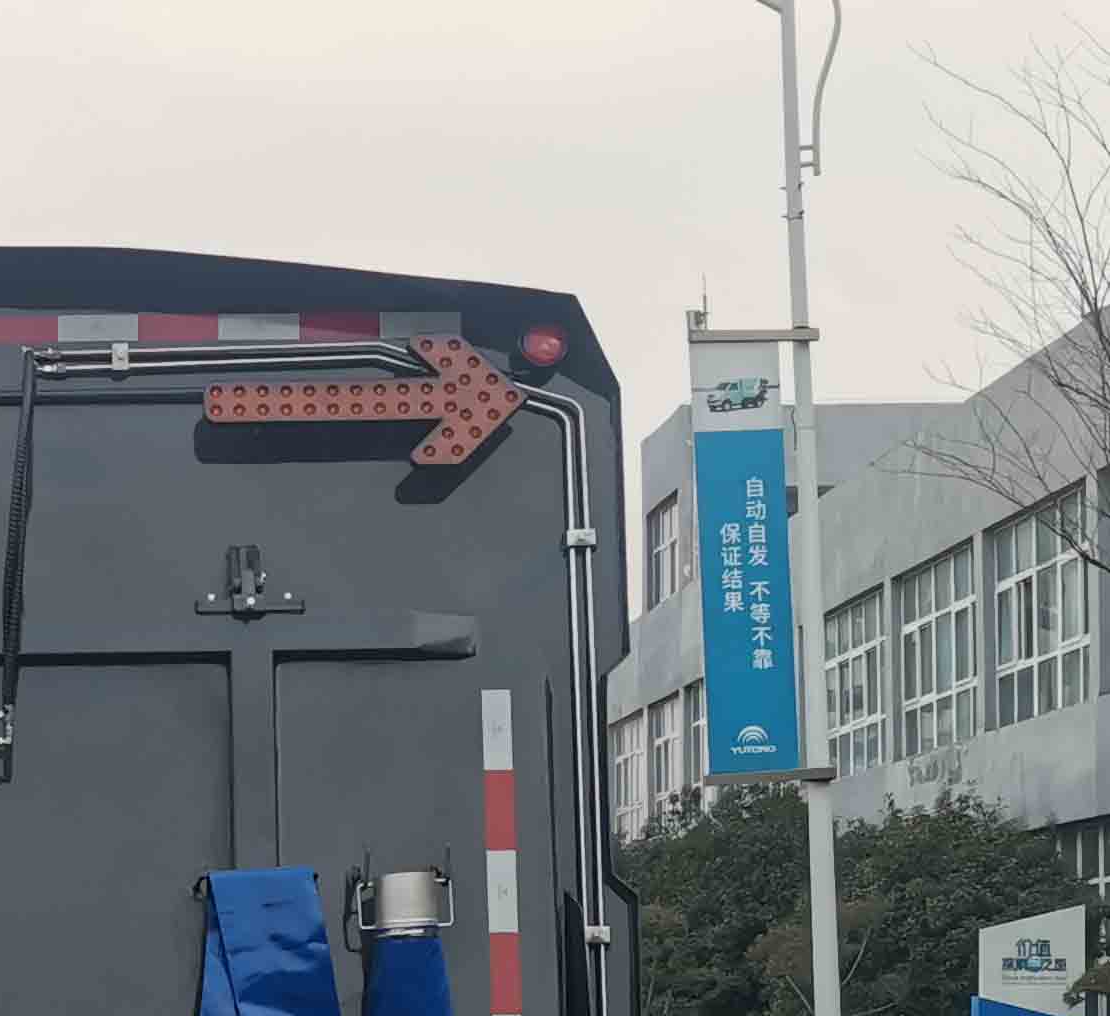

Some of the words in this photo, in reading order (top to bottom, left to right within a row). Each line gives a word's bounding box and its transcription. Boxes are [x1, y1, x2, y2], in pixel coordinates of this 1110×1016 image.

[746, 477, 769, 566] 自动自发
[720, 522, 745, 612] 保证结果
[749, 580, 774, 669] 不等不靠
